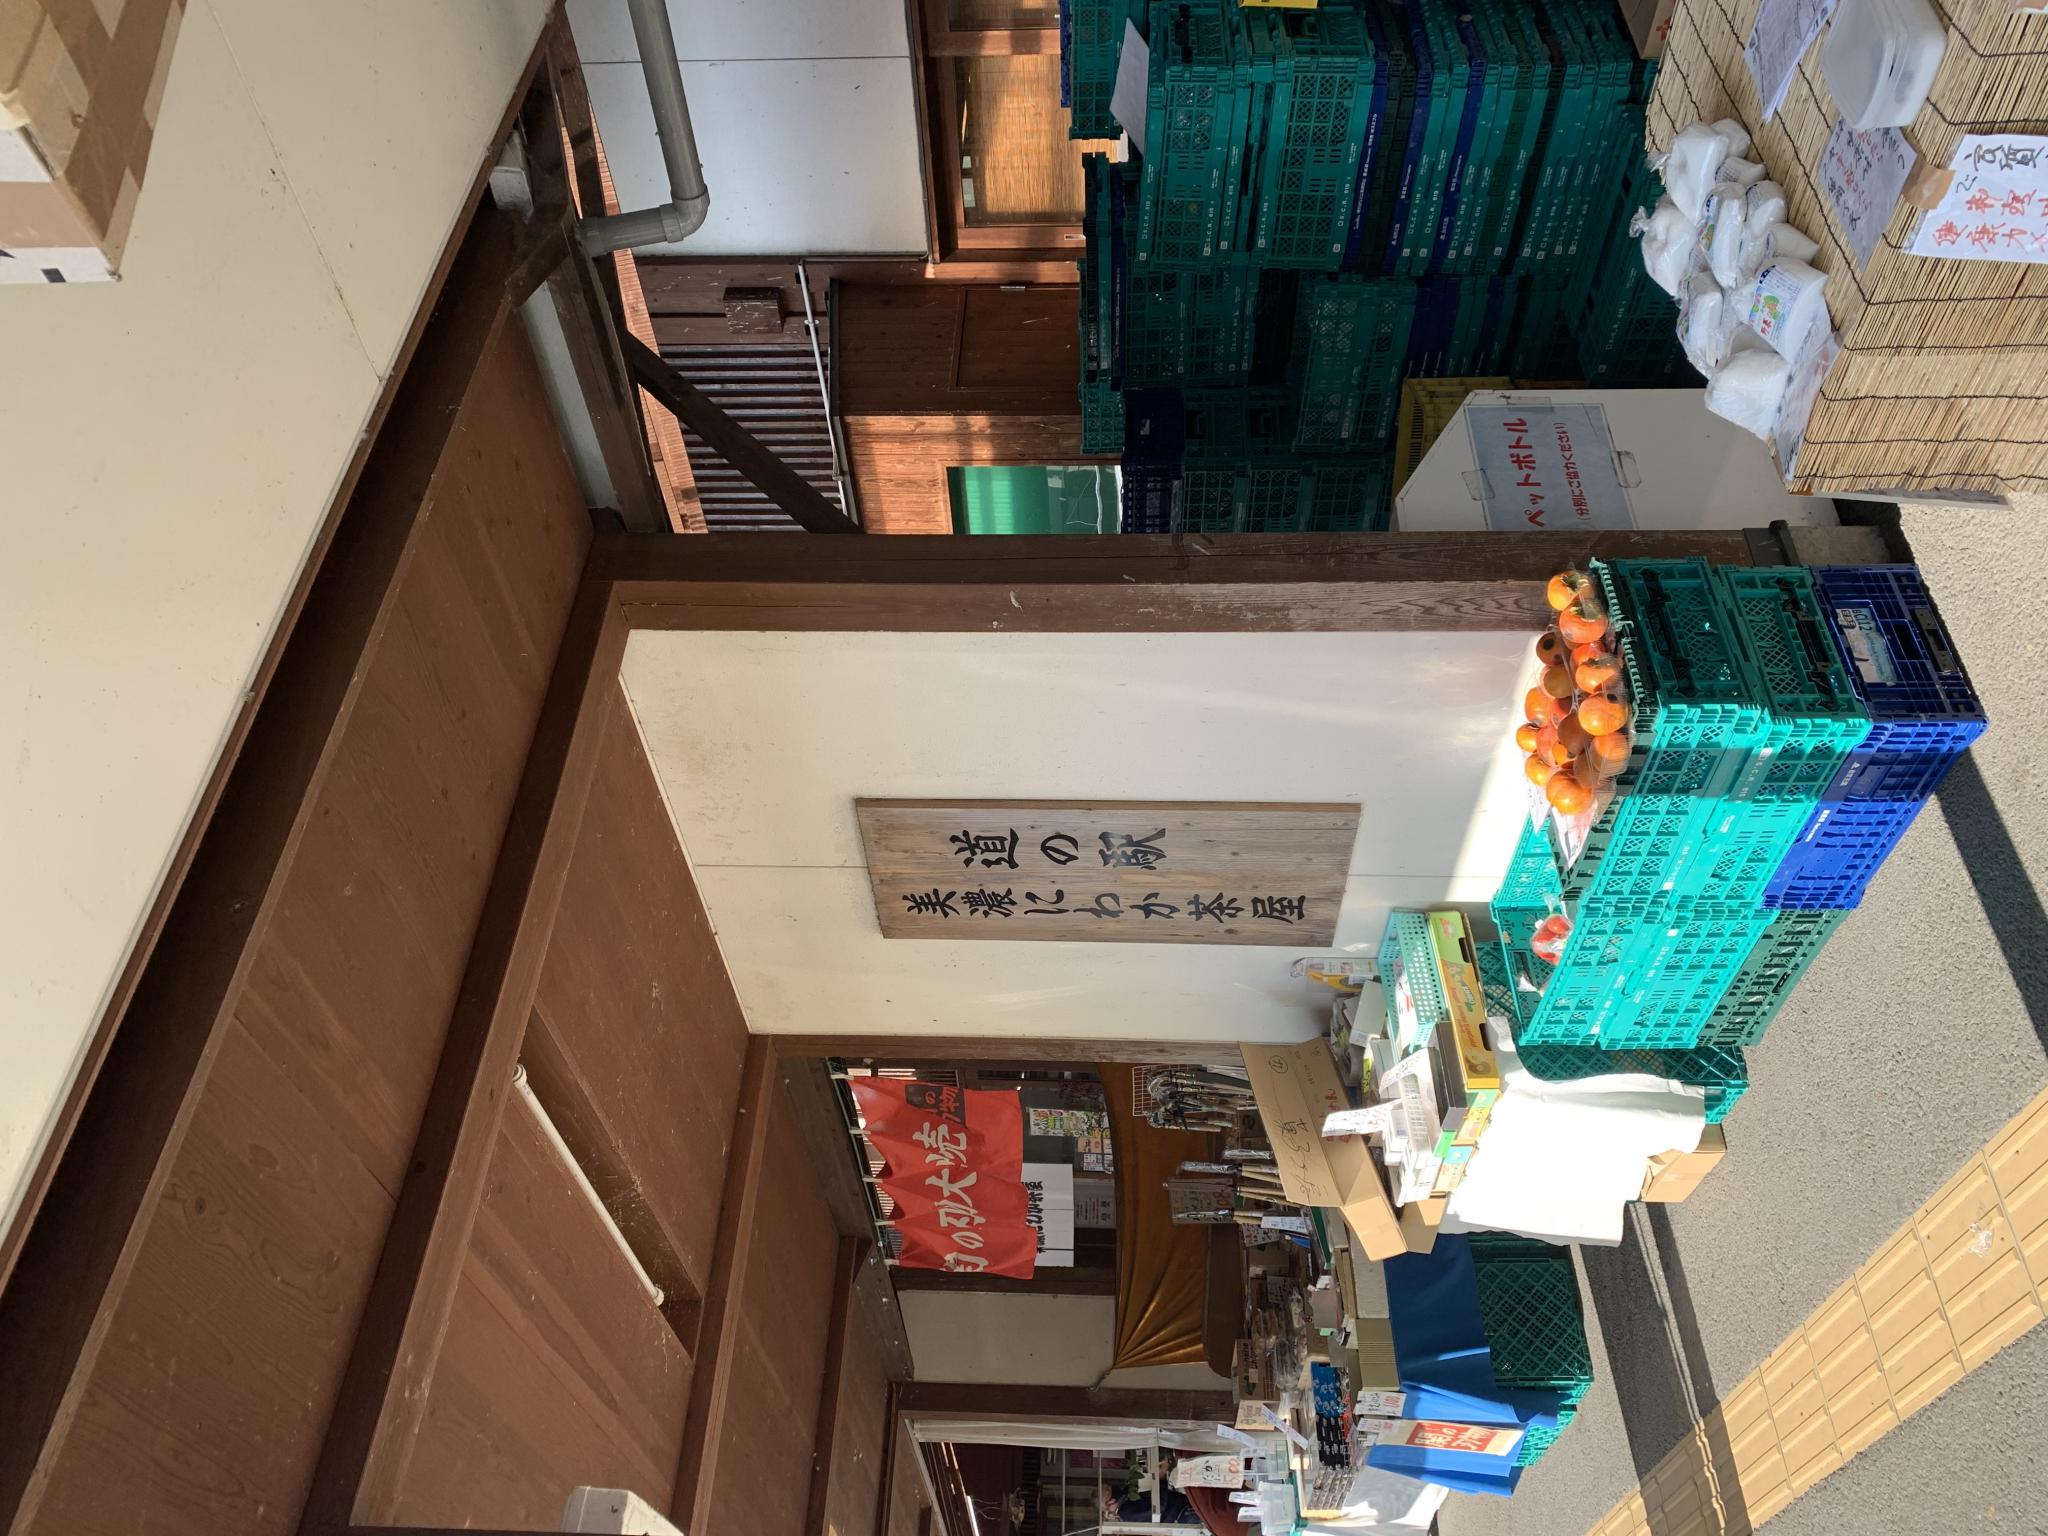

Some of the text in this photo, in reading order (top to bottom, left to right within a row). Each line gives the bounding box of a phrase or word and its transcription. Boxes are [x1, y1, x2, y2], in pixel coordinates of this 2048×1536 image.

[1503, 417, 1545, 528] ペットボトル
[949, 827, 1167, 870] 道の駅
[901, 888, 1306, 924] 美濃にわか茶屋
